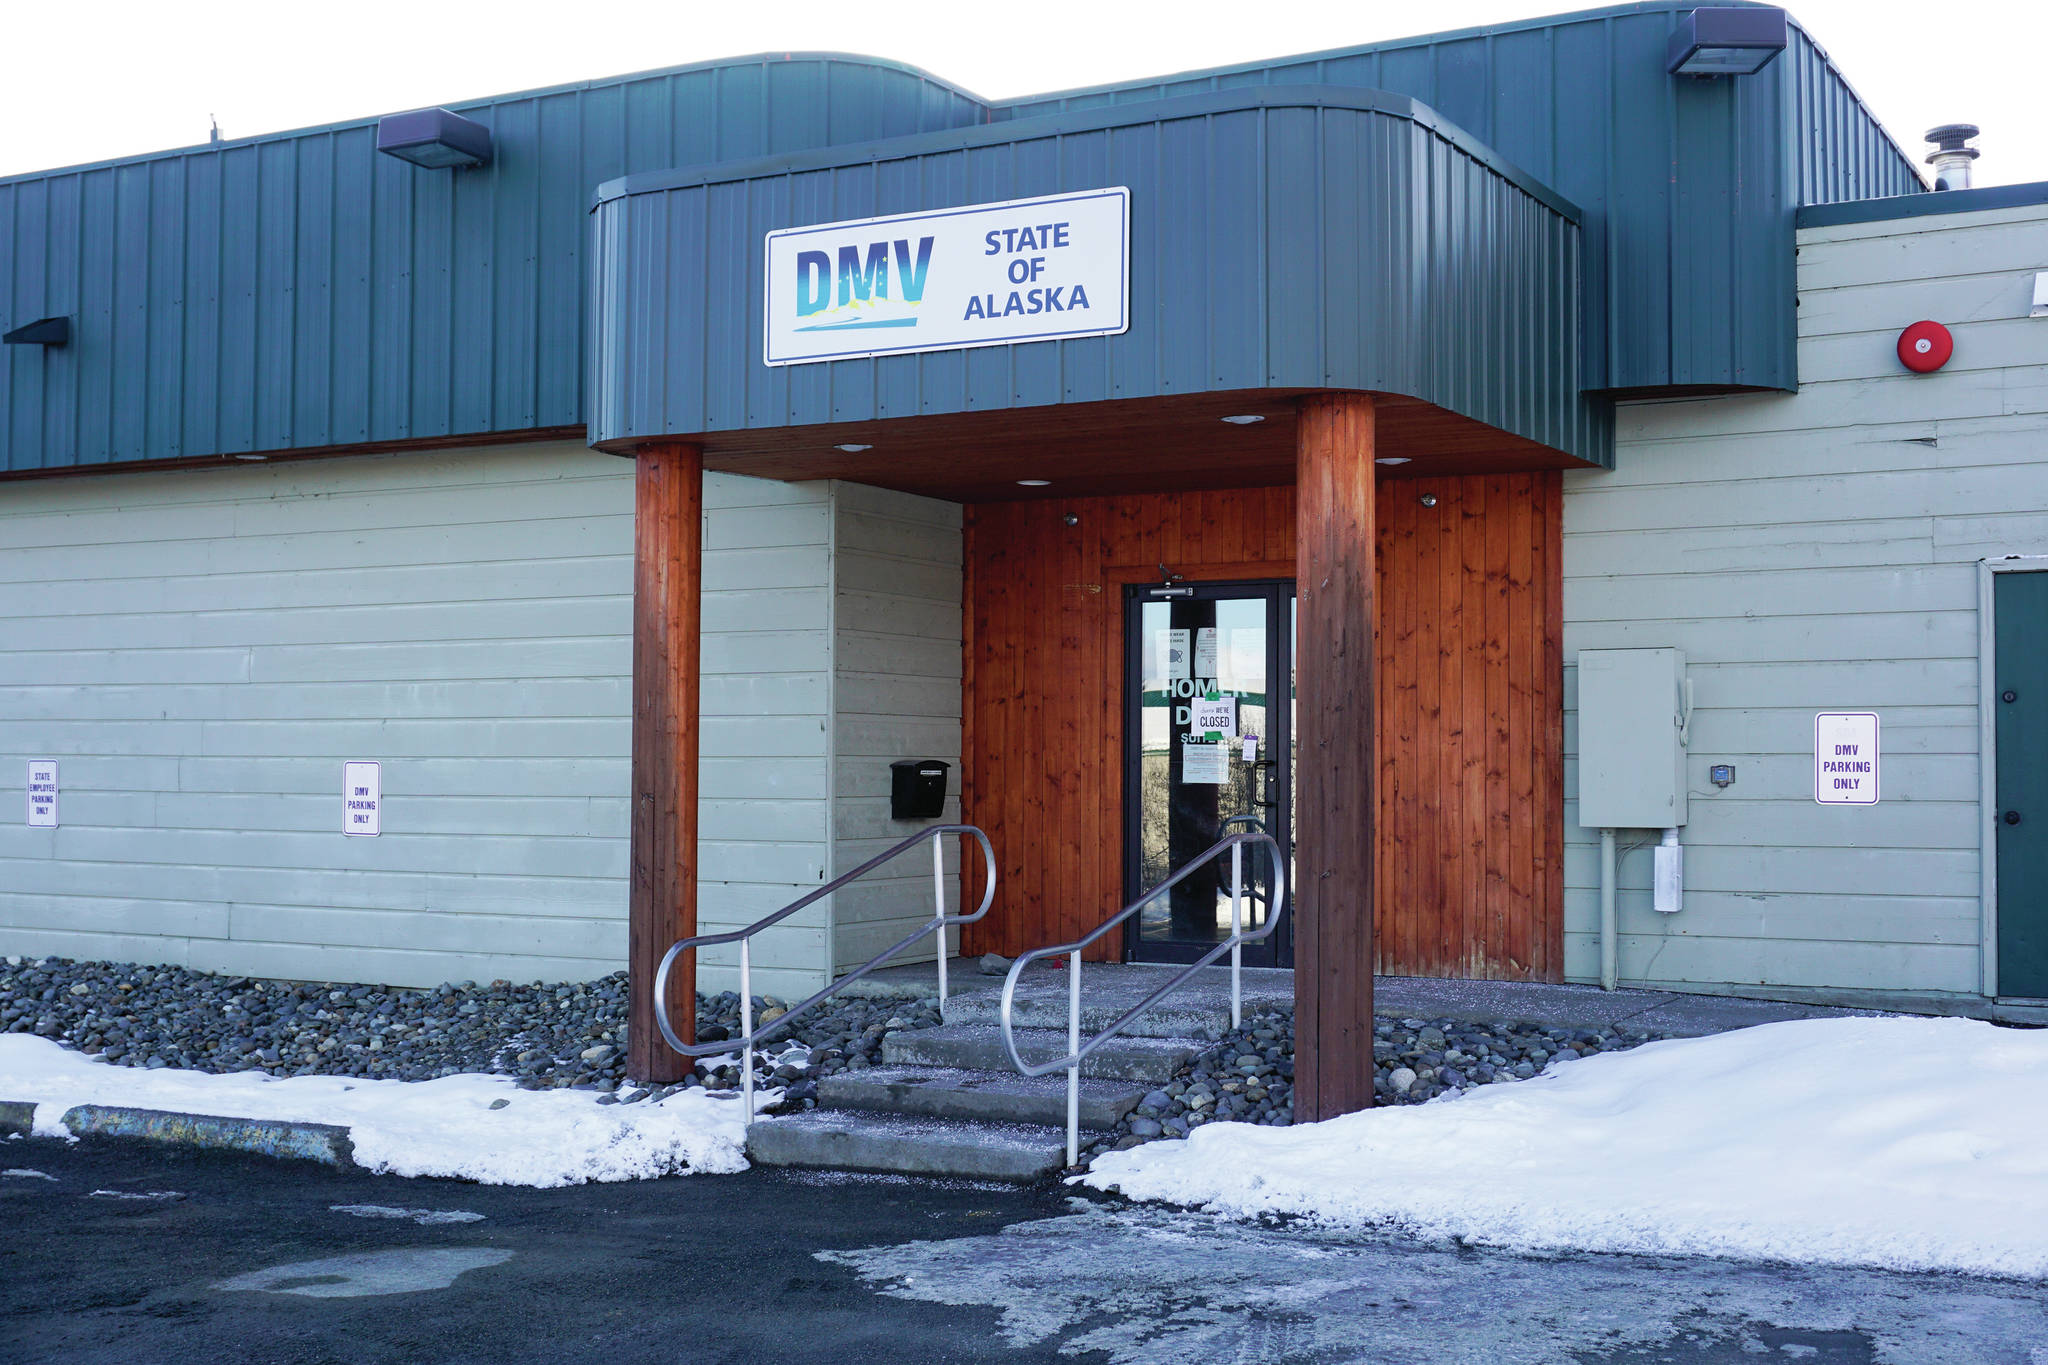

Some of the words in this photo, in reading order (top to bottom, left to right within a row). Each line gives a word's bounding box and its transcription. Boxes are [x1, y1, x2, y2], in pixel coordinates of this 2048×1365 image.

[985, 222, 1069, 255] STATE
[1007, 257, 1045, 284] OF
[797, 236, 935, 317] DMV
[963, 285, 1090, 320] ALASKA
[1200, 716, 1229, 727] CLOSED
[1835, 744, 1858, 755] DMV
[1823, 761, 1871, 772] PARKING
[35, 772, 50, 780] STATE
[30, 784, 55, 792] EMPLOYEE
[1833, 778, 1860, 789] ONLY
[354, 787, 369, 796] DMV
[32, 795, 53, 803] PARKING
[36, 806, 48, 814] ONLY
[347, 801, 376, 810] PARKING
[353, 814, 369, 823] ONLY
